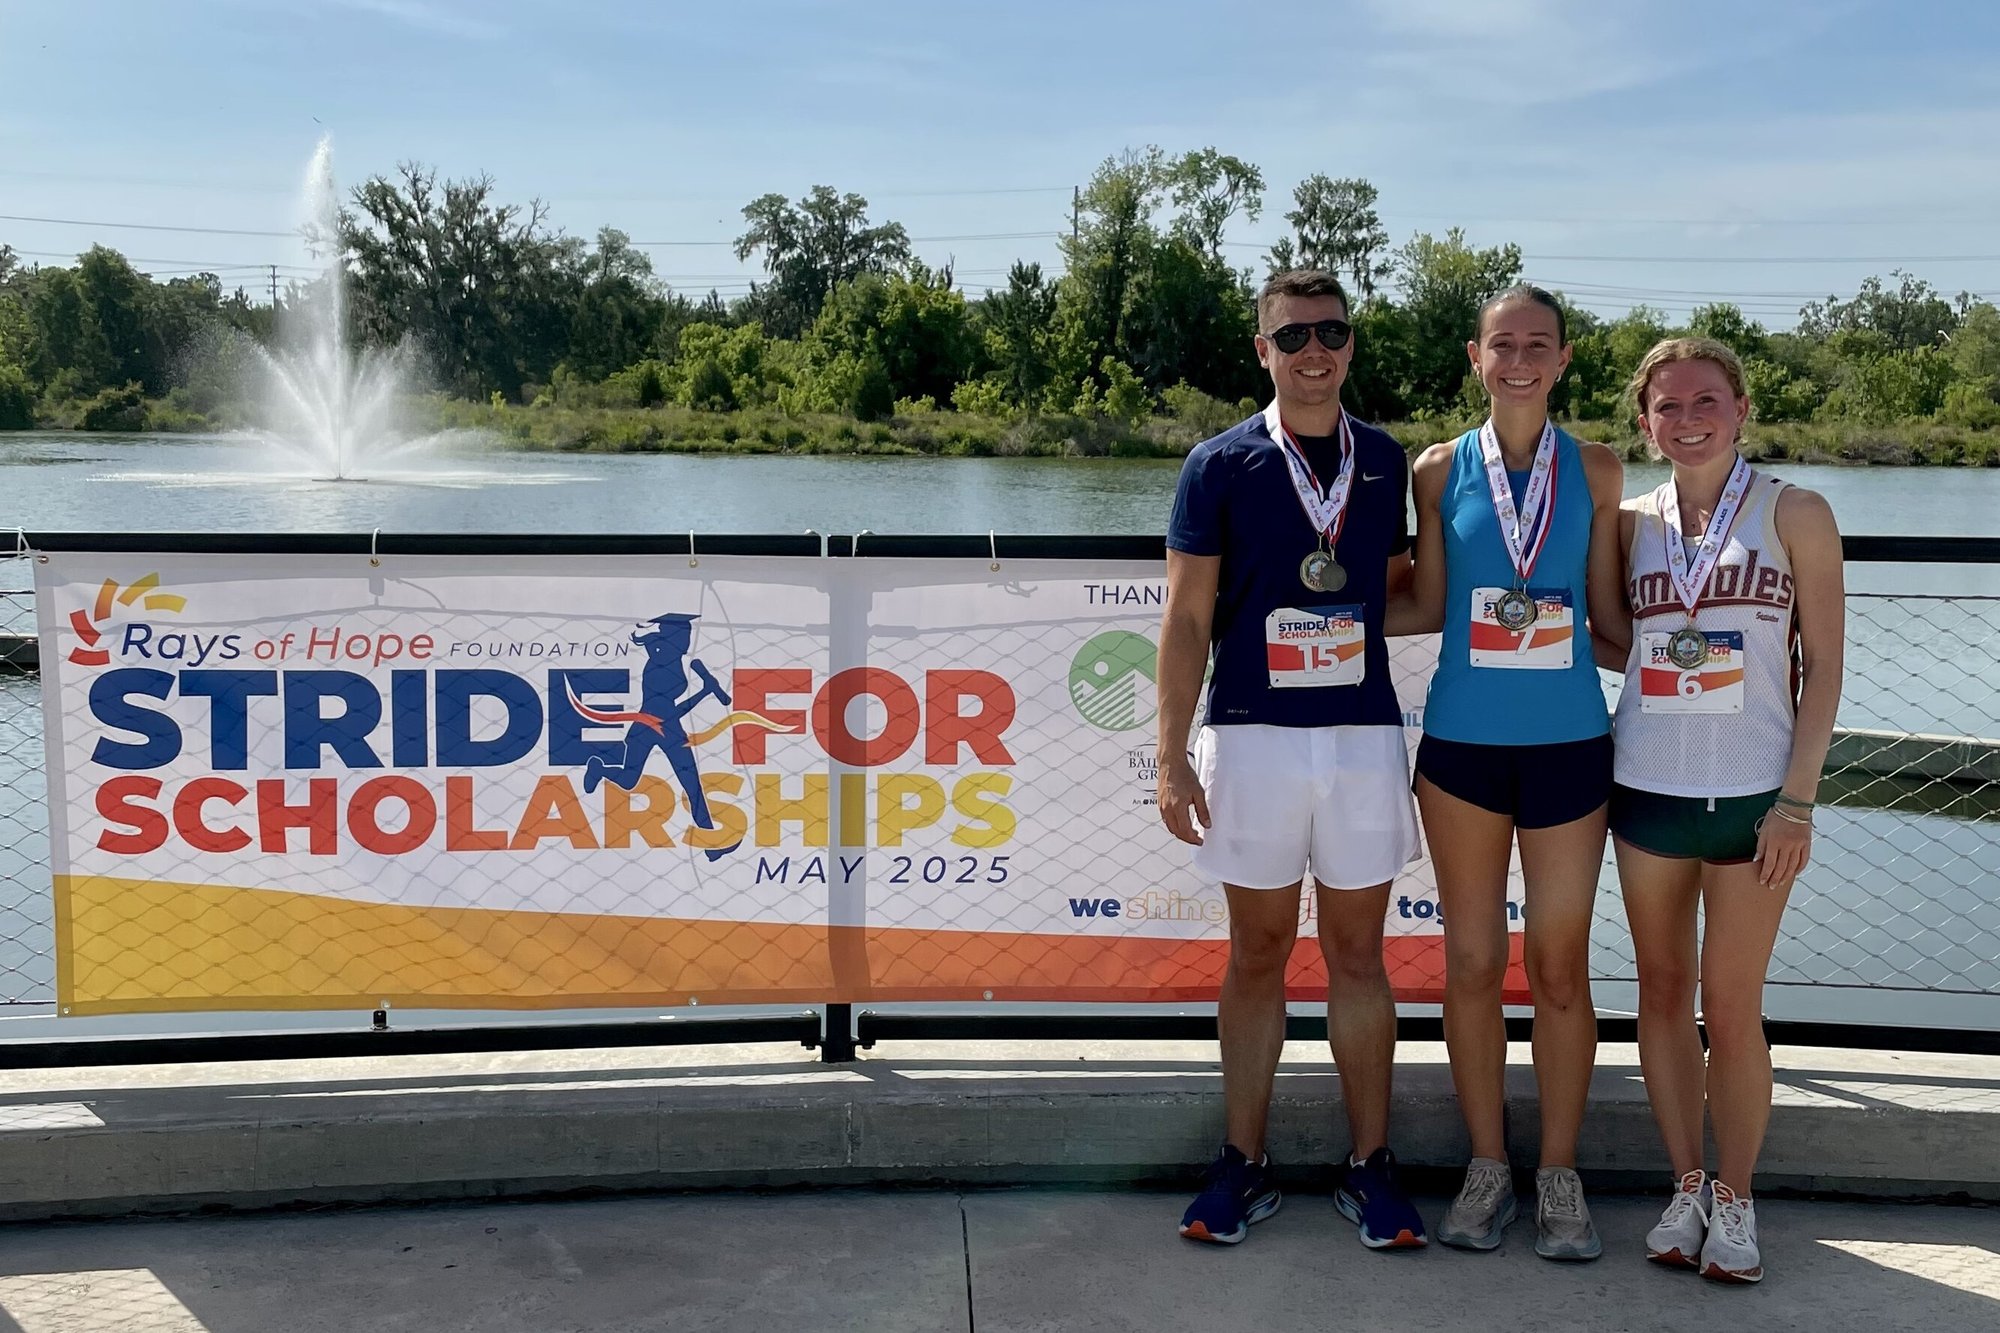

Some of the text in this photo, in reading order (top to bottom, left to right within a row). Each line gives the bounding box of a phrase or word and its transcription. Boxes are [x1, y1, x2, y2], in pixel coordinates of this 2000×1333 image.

[1084, 585, 1169, 605] THAN
[1279, 619, 1354, 631] STRIDE FOR
[1511, 625, 1536, 655] 7
[121, 623, 630, 668] Rays of Hope FOUNDATION
[1297, 641, 1341, 675] 15
[1676, 668, 1703, 701] 6
[88, 666, 1017, 771] STRIDE FOR
[1129, 758, 1158, 768] BAIL
[95, 772, 1018, 857] SCHOLARSHIPS
[754, 856, 1010, 885] MAY 2025
[1068, 898, 1122, 918] we
[1126, 889, 1226, 922] shine
